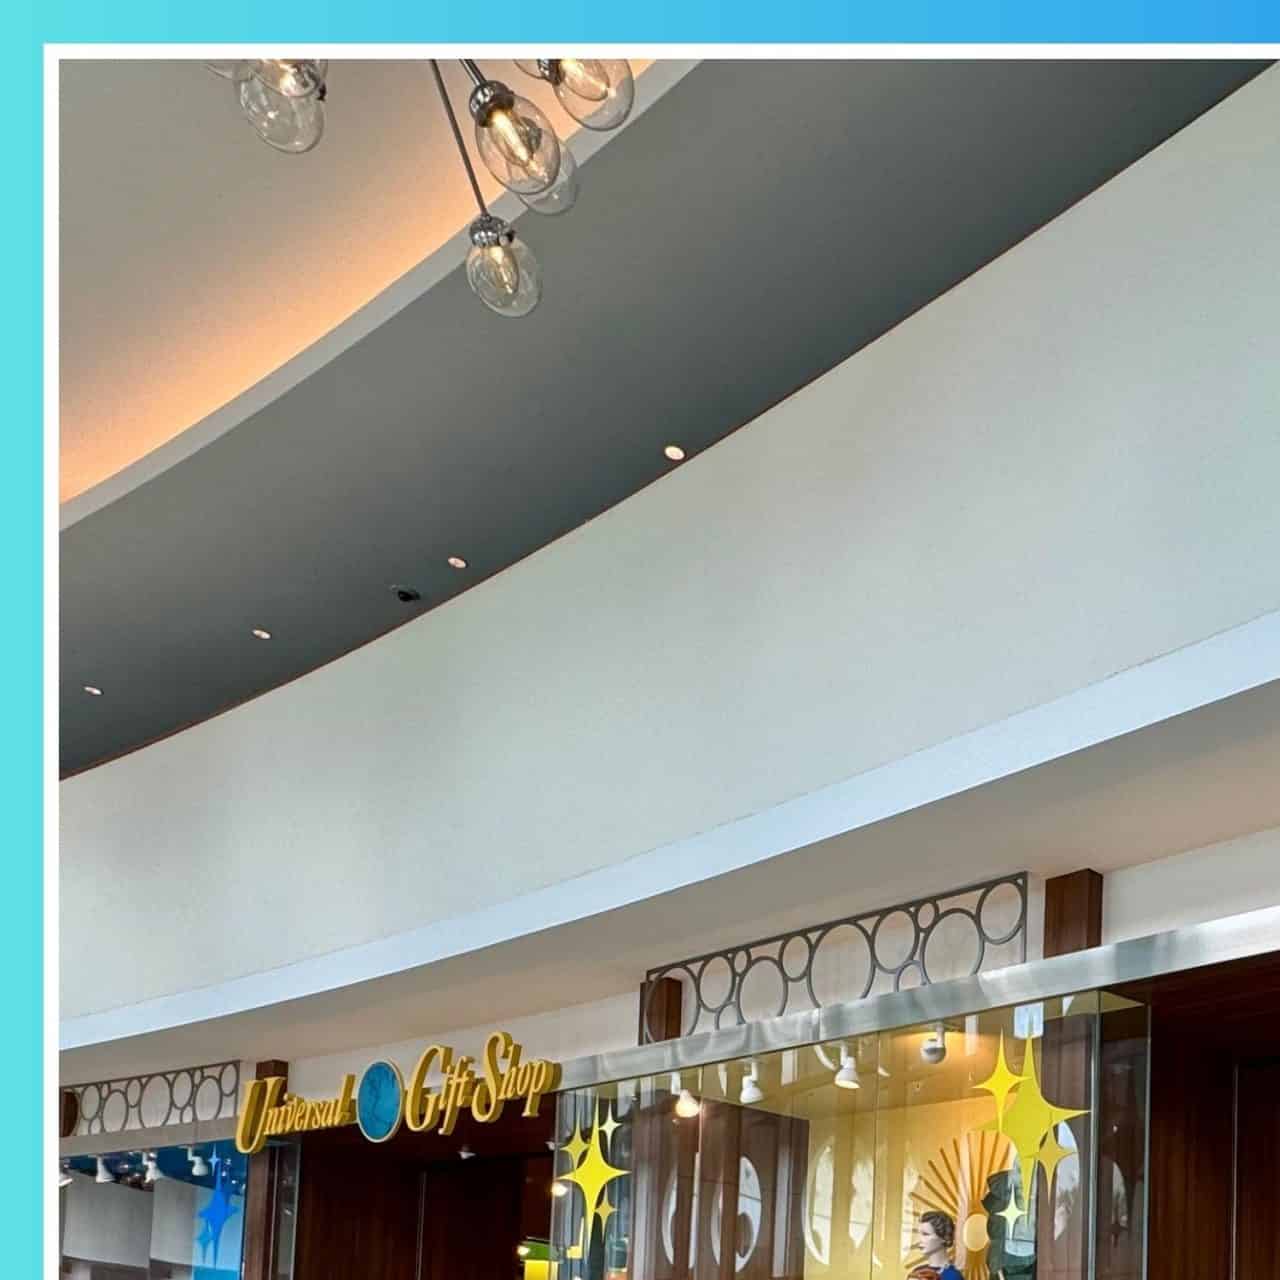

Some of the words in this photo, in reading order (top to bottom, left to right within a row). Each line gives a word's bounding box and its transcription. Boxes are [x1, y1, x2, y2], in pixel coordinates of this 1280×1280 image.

[236, 1074, 357, 1153] Universal
[405, 1044, 474, 1135] Gift
[472, 1032, 560, 1123] Shop
